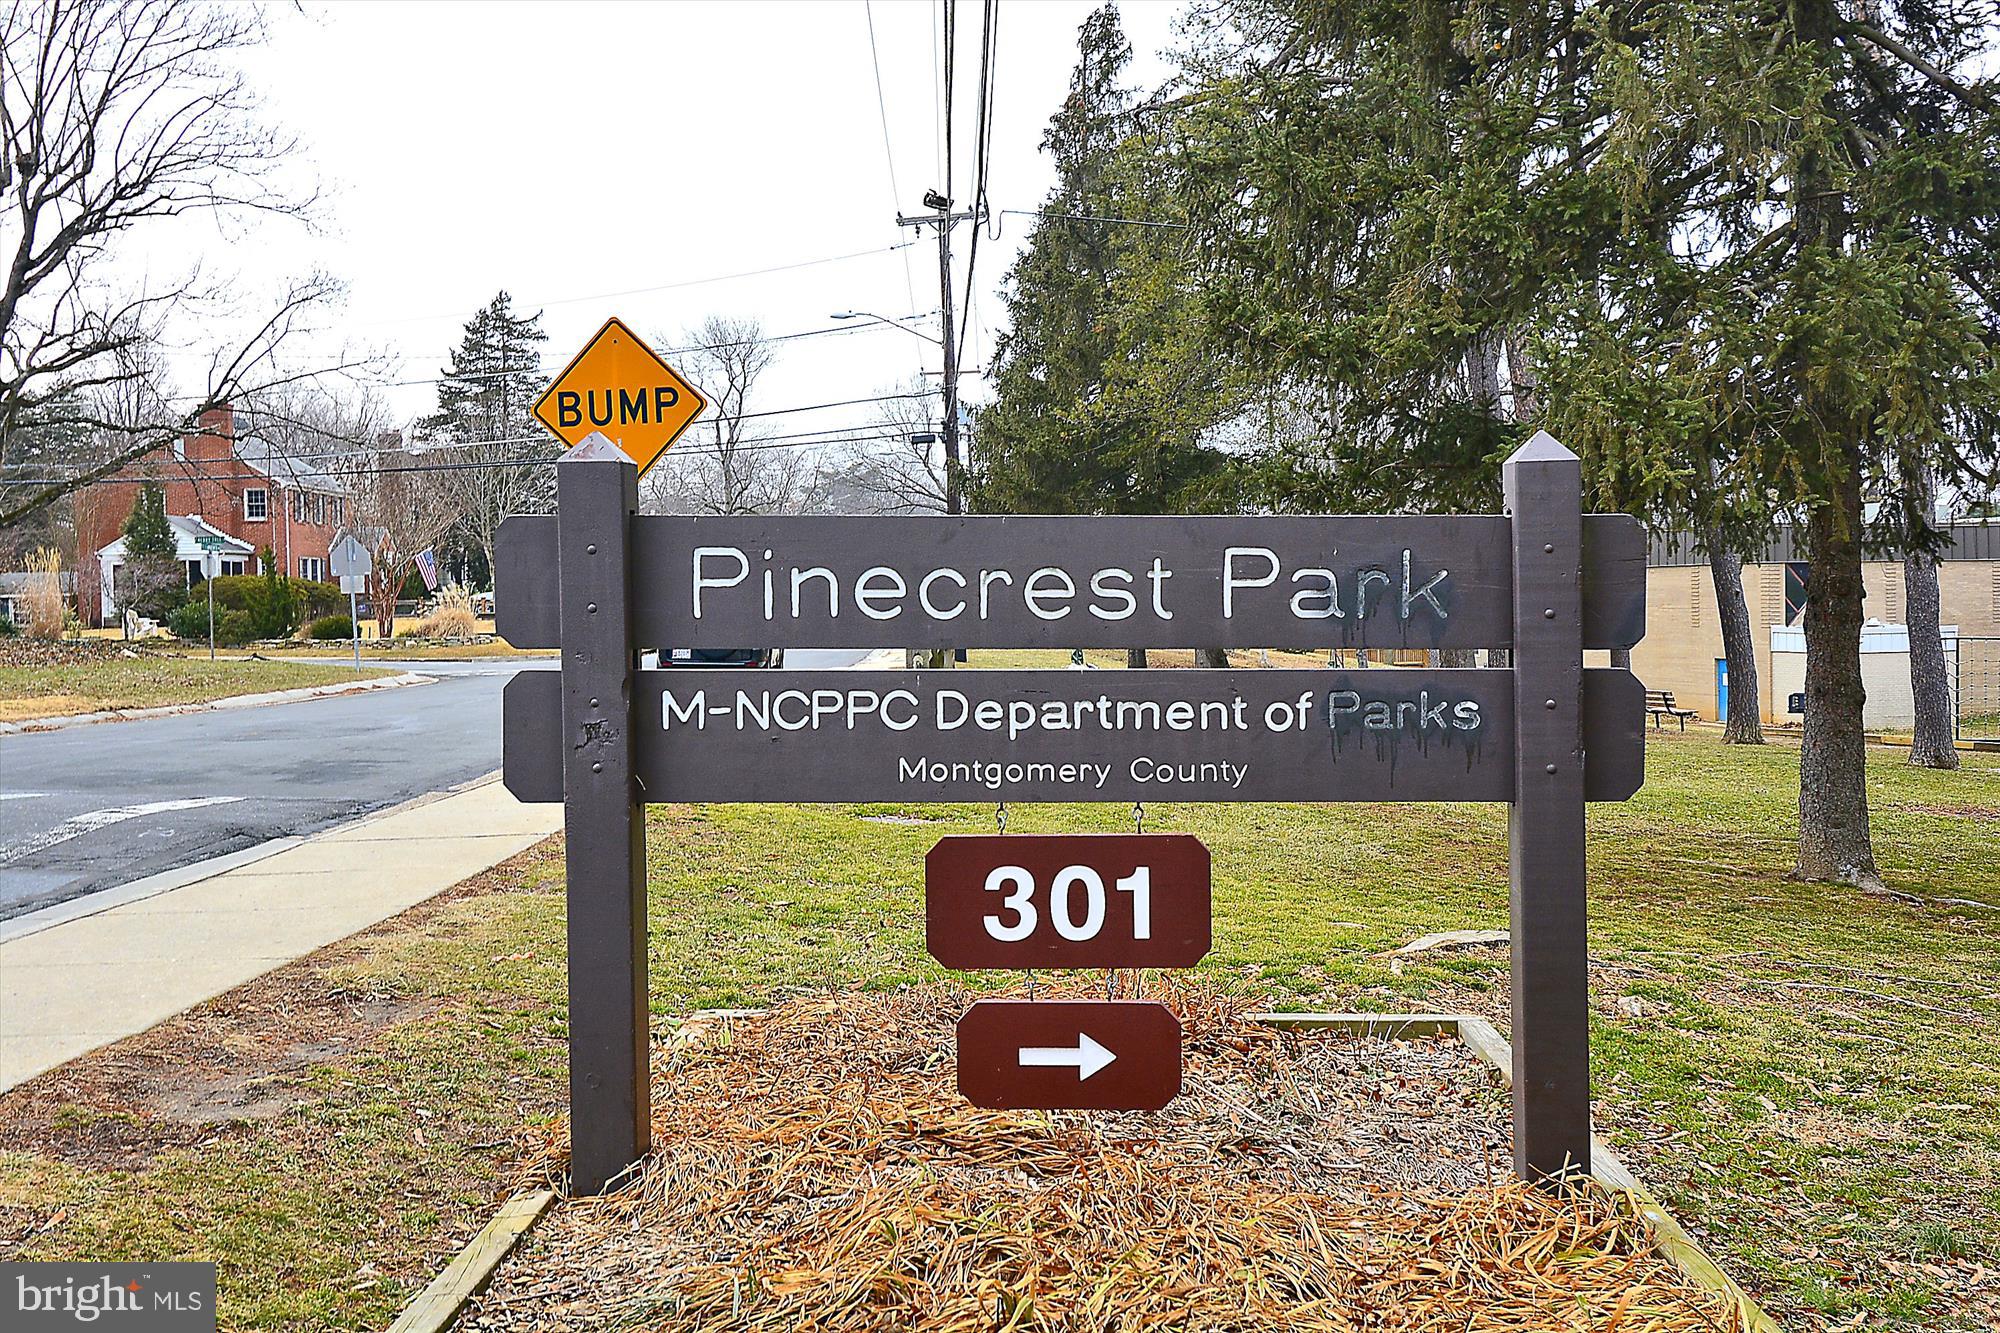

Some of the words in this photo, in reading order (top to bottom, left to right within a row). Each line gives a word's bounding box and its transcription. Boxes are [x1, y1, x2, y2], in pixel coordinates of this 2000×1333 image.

[557, 387, 680, 428] BUMP
[692, 545, 1174, 621] Pinecrest
[1222, 545, 1450, 621] Park
[660, 689, 919, 731] M-NCPPC
[936, 689, 1249, 741] Department
[1264, 690, 1314, 732] of
[1327, 689, 1482, 732] Parks
[897, 756, 1111, 789] Montgomery
[1129, 756, 1249, 789] County
[982, 864, 1151, 943] 301
